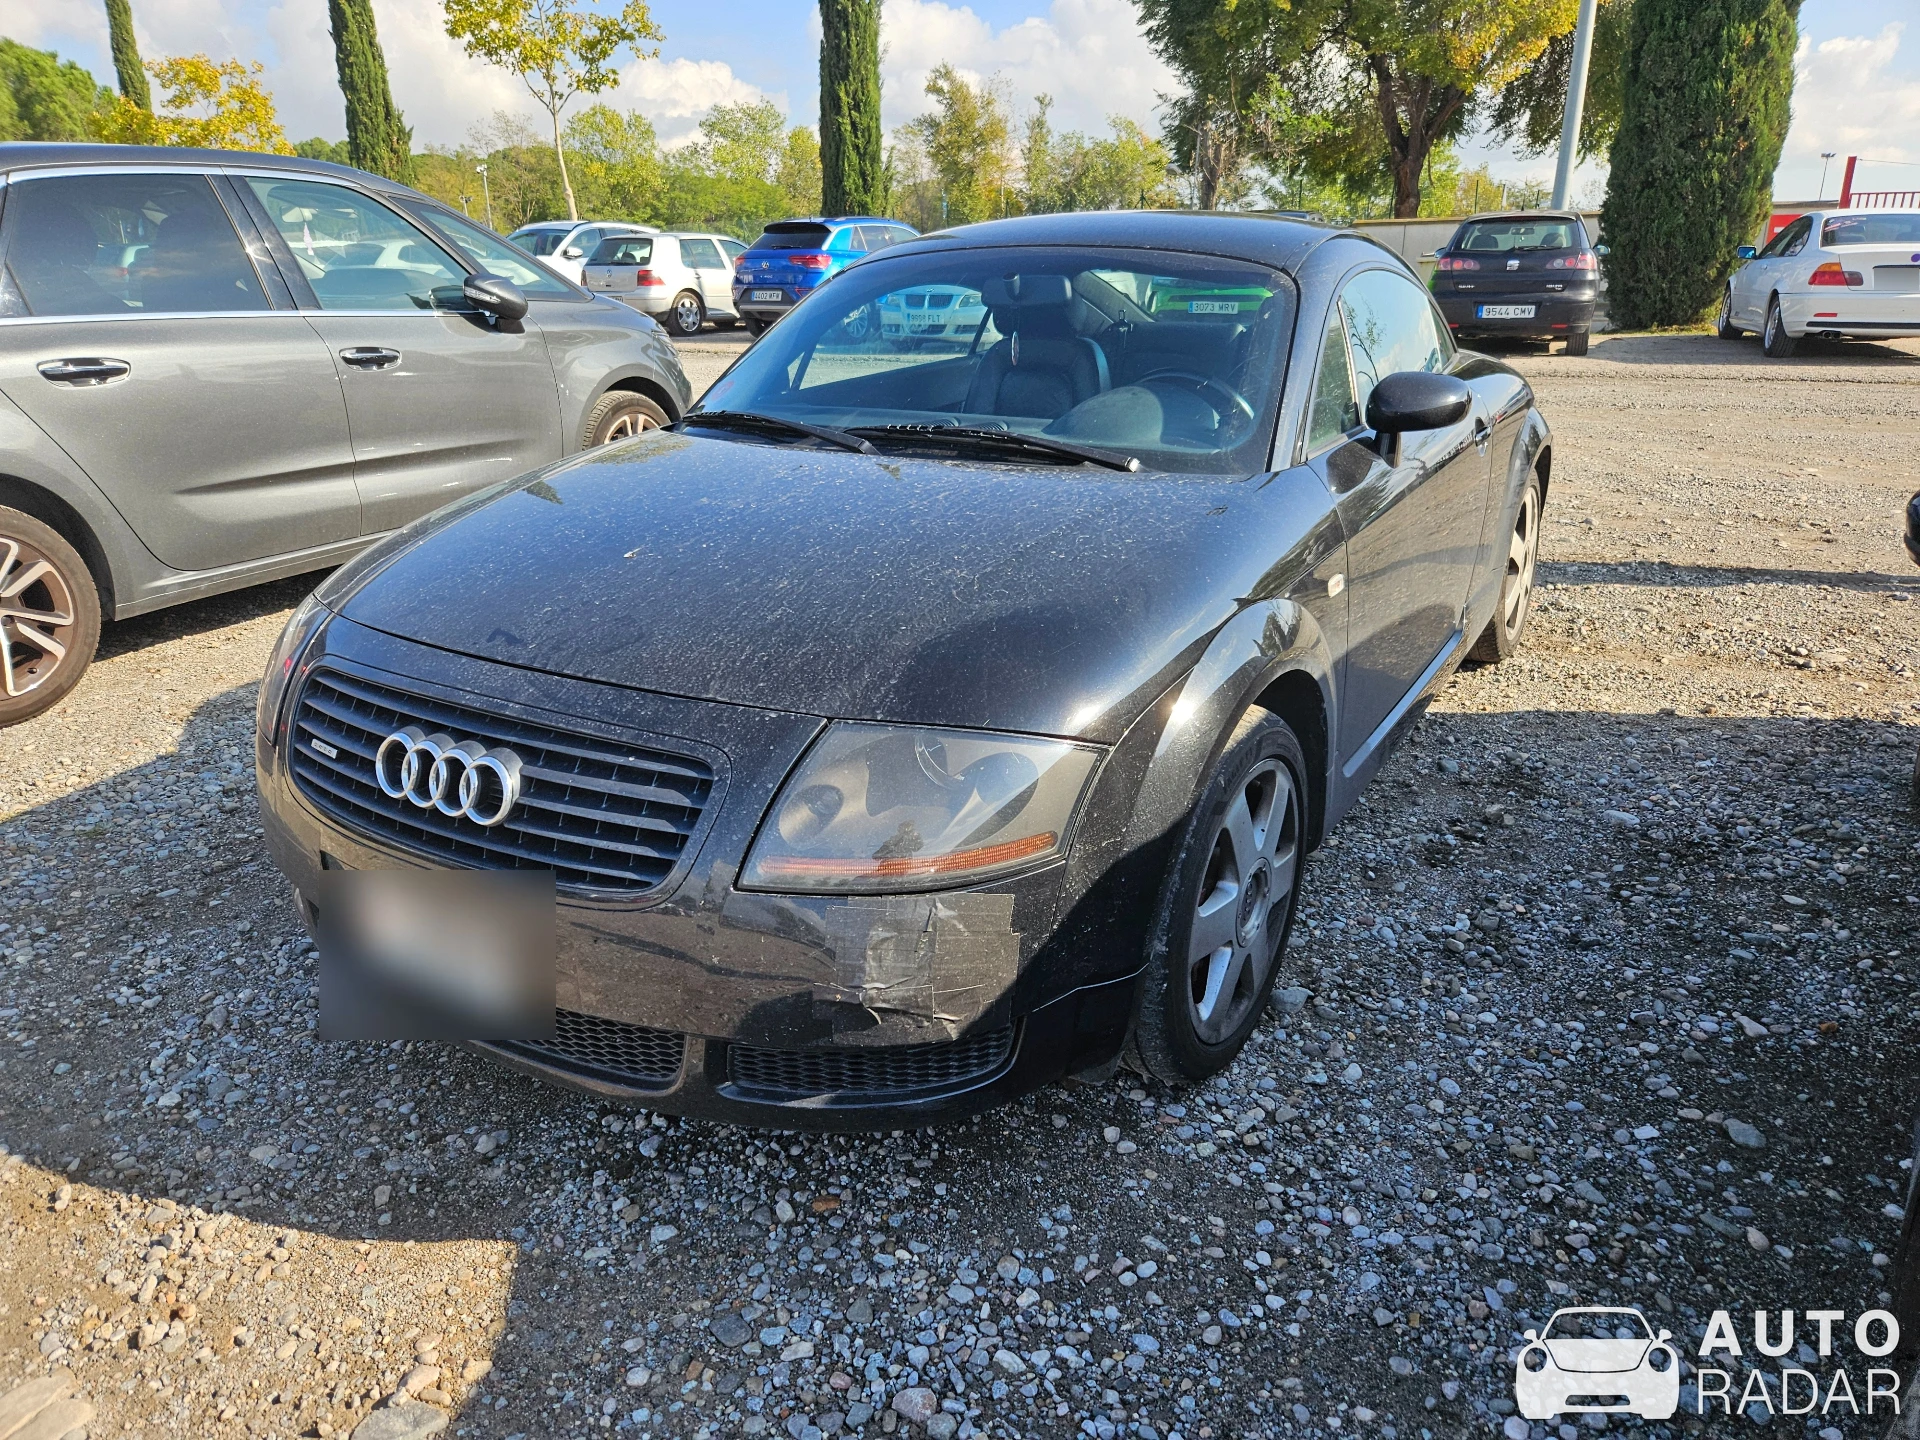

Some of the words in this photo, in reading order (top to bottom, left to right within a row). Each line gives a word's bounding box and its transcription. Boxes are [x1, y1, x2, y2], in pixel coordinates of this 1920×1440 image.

[1194, 302, 1215, 312] 3073
[1218, 303, 1237, 312] MRV
[1485, 307, 1510, 316] 9544
[1513, 307, 1533, 316] CMV
[927, 314, 941, 323] FLT
